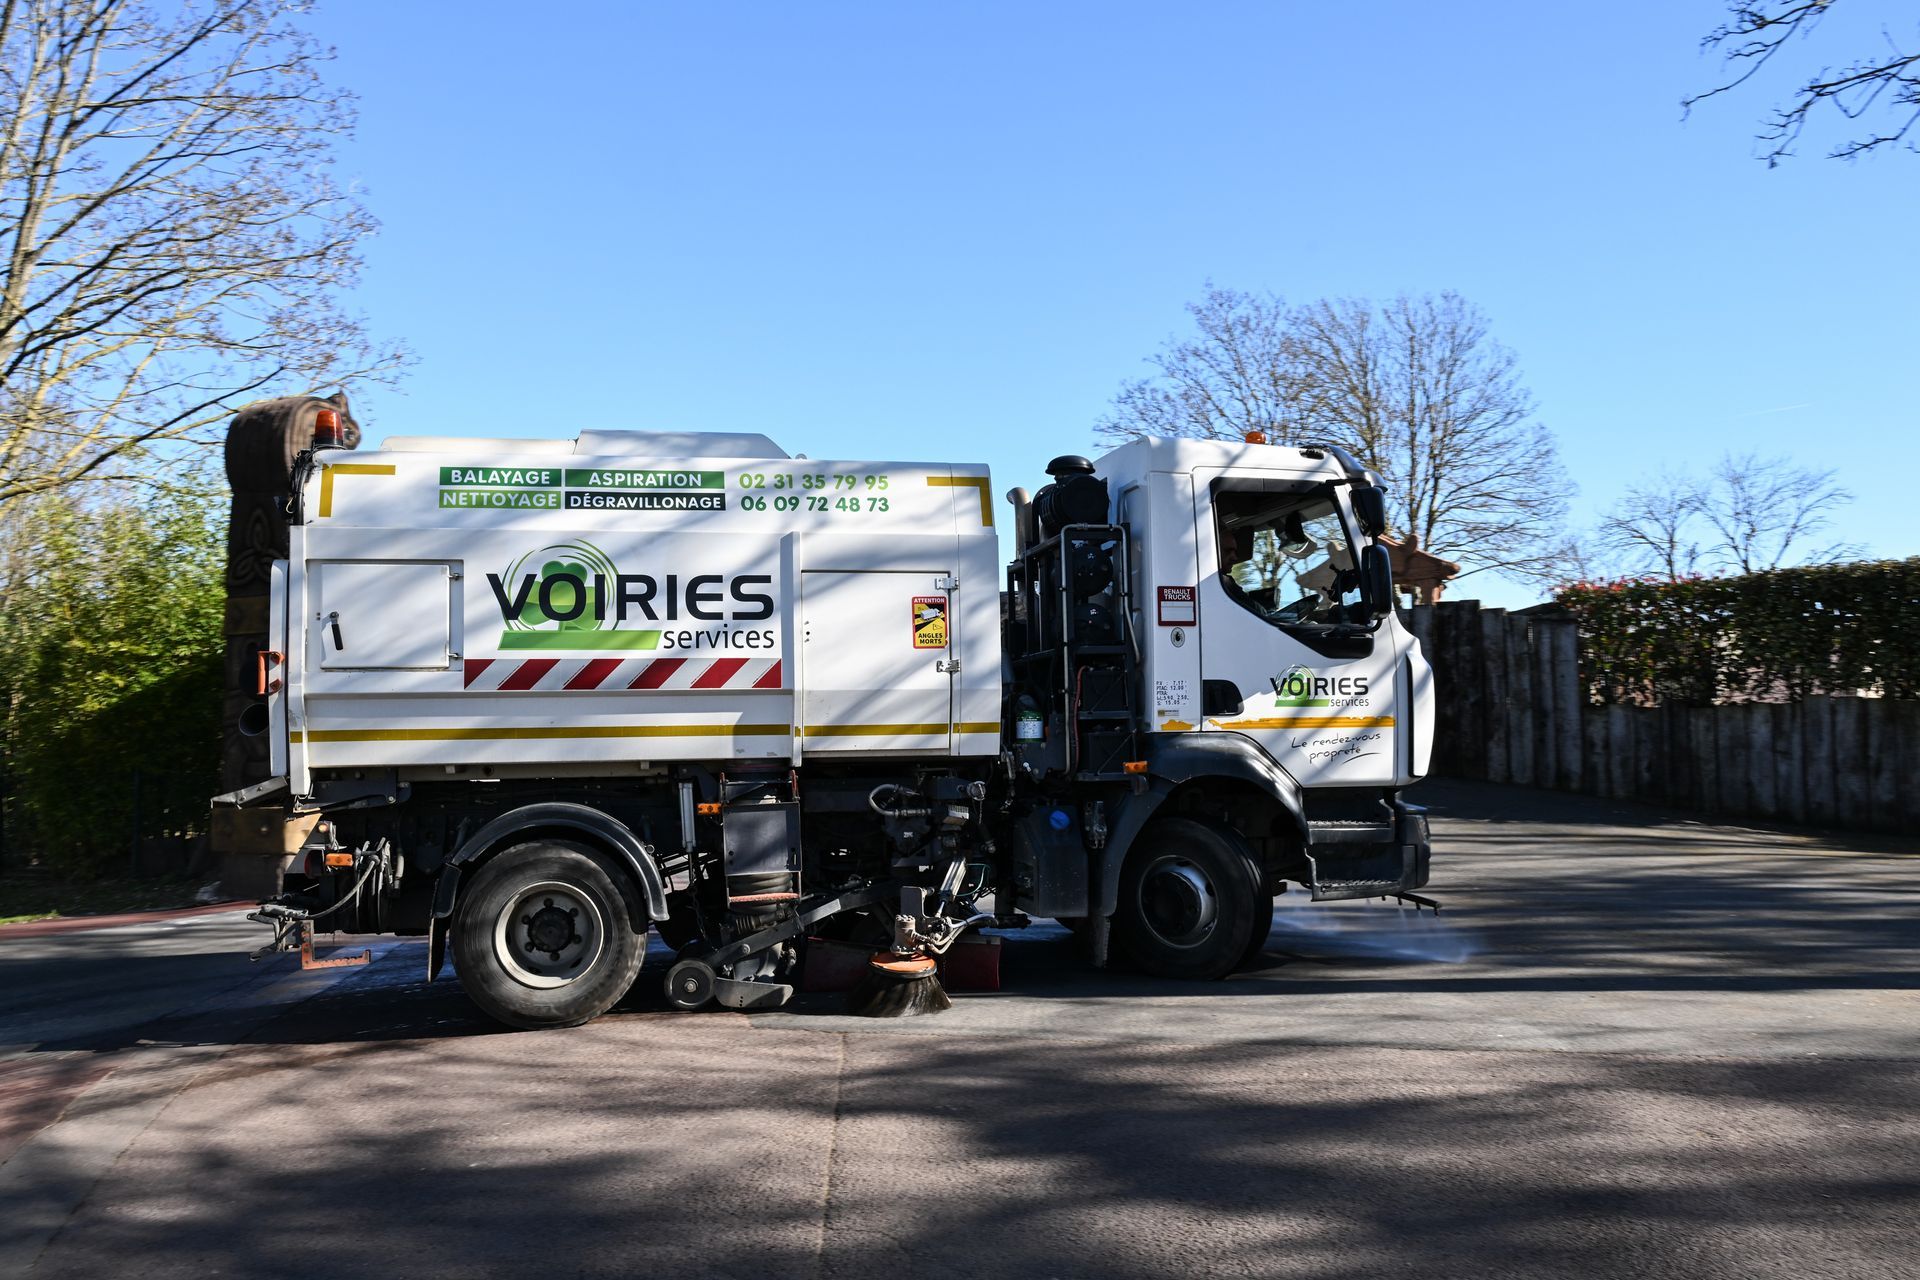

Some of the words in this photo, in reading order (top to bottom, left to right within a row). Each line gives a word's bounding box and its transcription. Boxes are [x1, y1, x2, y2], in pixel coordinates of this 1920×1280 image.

[451, 469, 550, 485] BALAYAGE
[588, 471, 701, 487] ASPIRATION
[739, 473, 766, 489] 02
[773, 473, 793, 490] 31
[802, 474, 826, 490] 35
[833, 474, 857, 490] 79
[864, 475, 889, 491] 95
[443, 492, 557, 507] NETTOYAGE
[570, 492, 721, 509] DÉGRAVILLONAGE
[740, 495, 767, 512] 06
[773, 495, 800, 512] 09
[806, 496, 829, 512] 72
[835, 496, 861, 512] 48
[867, 497, 890, 512] 73
[485, 572, 775, 621] VOIRIES
[662, 623, 775, 649] services
[1269, 677, 1369, 696] VOIRIES
[1329, 696, 1370, 707] services
[1291, 737, 1308, 748] Le
[1312, 732, 1381, 747] rendez-vous
